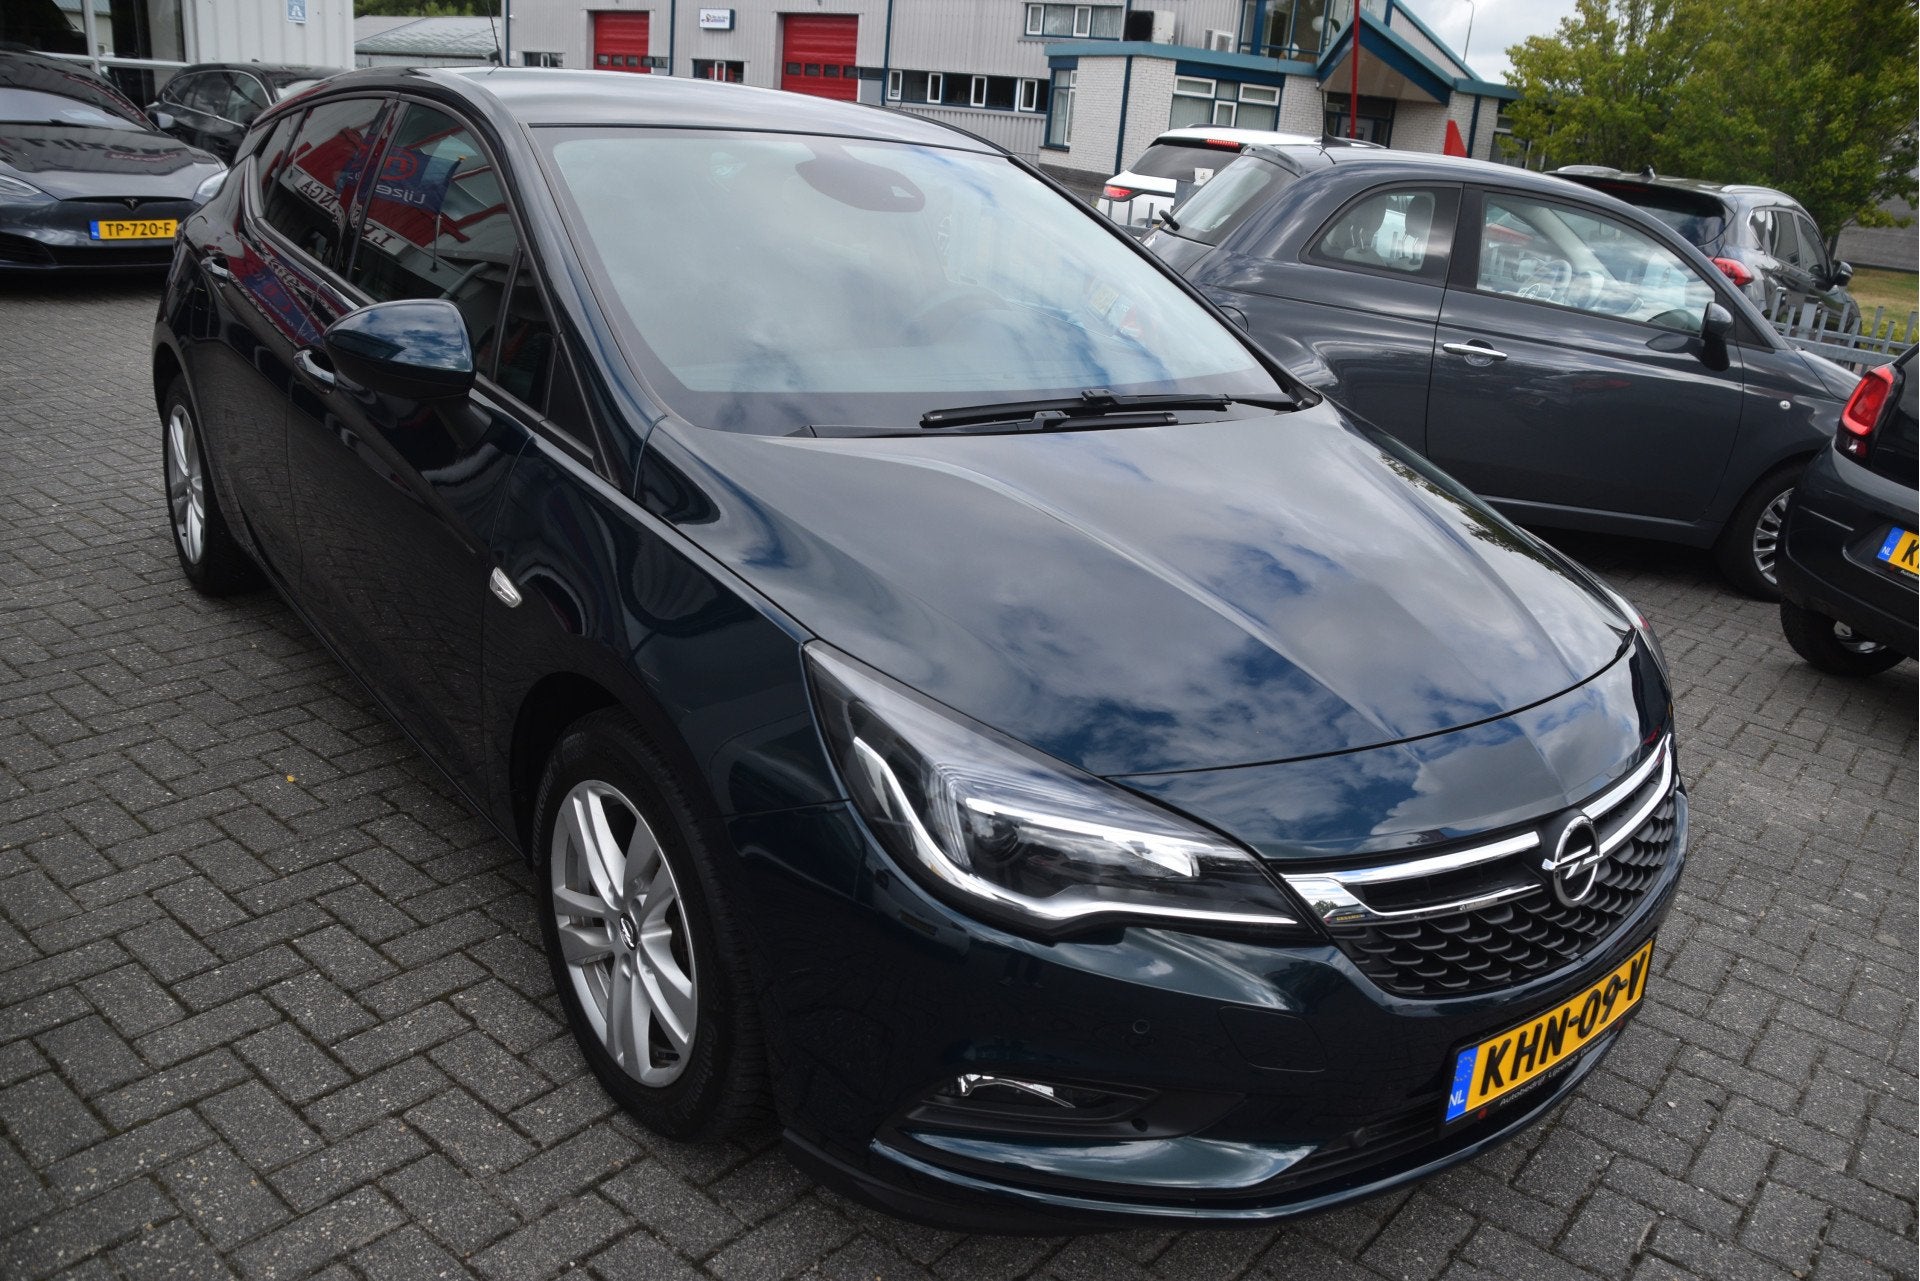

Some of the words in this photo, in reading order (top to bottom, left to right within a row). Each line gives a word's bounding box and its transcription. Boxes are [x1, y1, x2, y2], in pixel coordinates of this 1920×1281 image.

[105, 222, 171, 236] TP-720-F
[1882, 546, 1891, 556] NL
[1480, 951, 1647, 1096] KHN-09-V
[1450, 1089, 1465, 1107] NL
